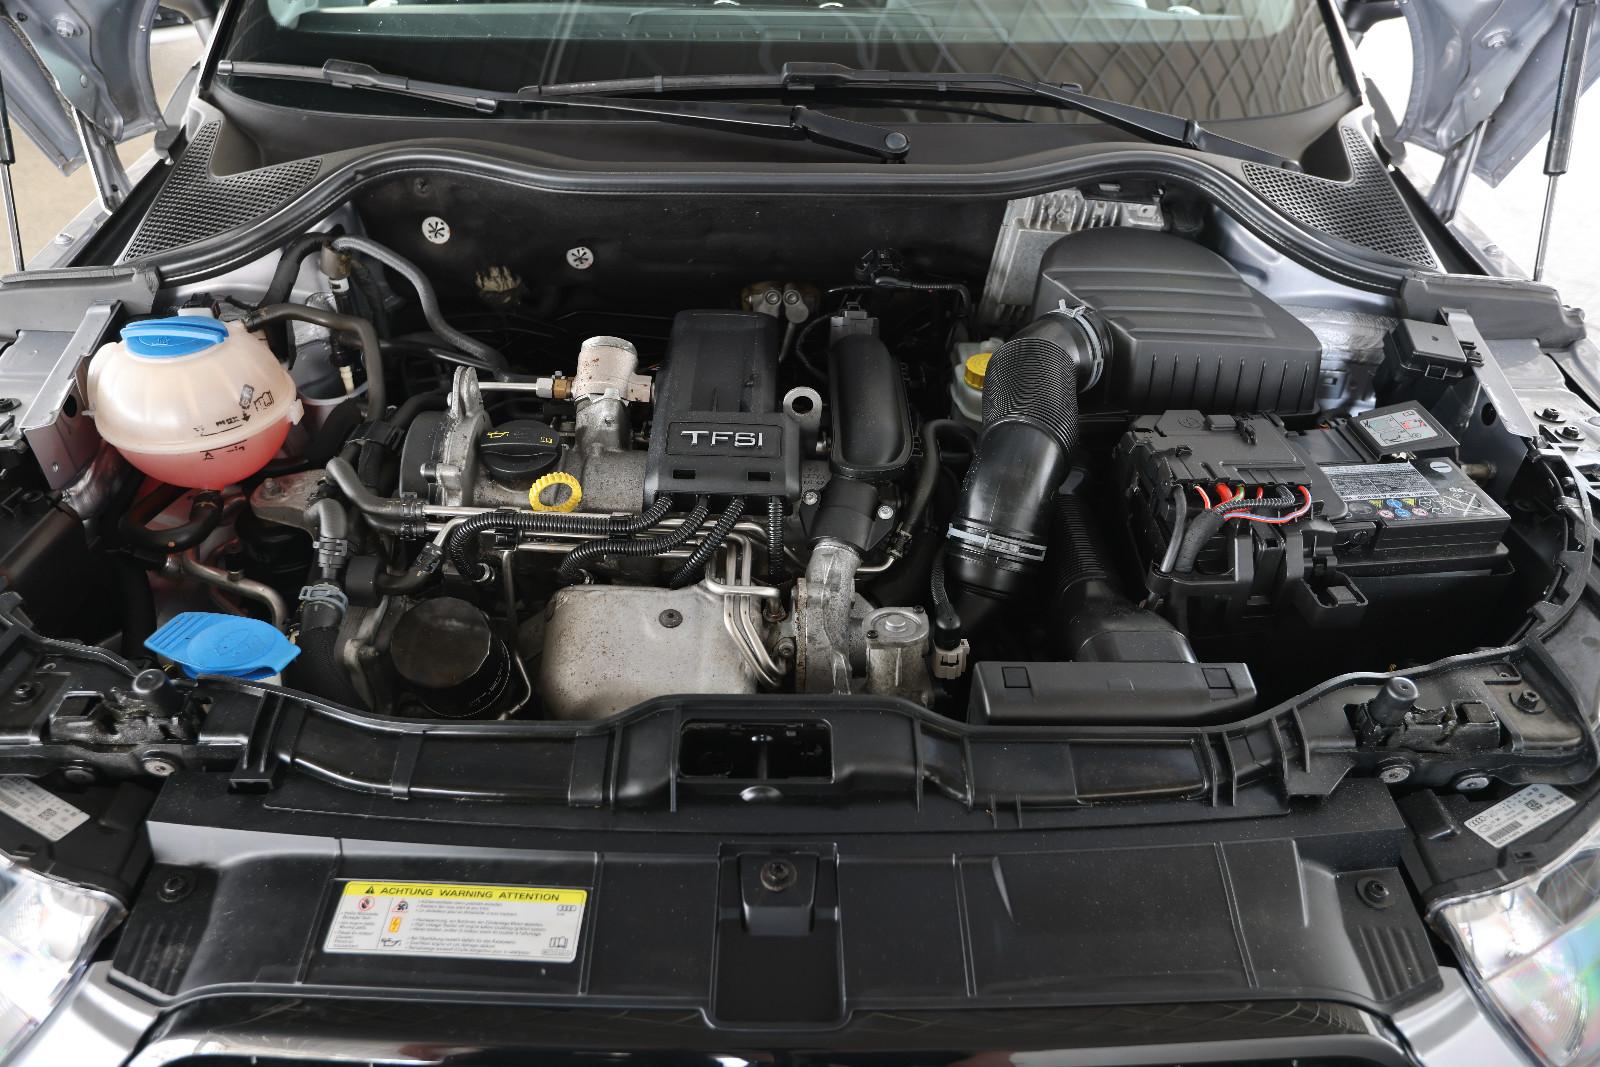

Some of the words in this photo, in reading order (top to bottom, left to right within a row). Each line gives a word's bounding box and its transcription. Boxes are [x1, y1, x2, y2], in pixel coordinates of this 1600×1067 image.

[681, 430, 763, 447] TFSI
[380, 888, 434, 897] ACHTUNG
[440, 890, 494, 899] WARNING
[498, 892, 561, 901] ATTENTION
